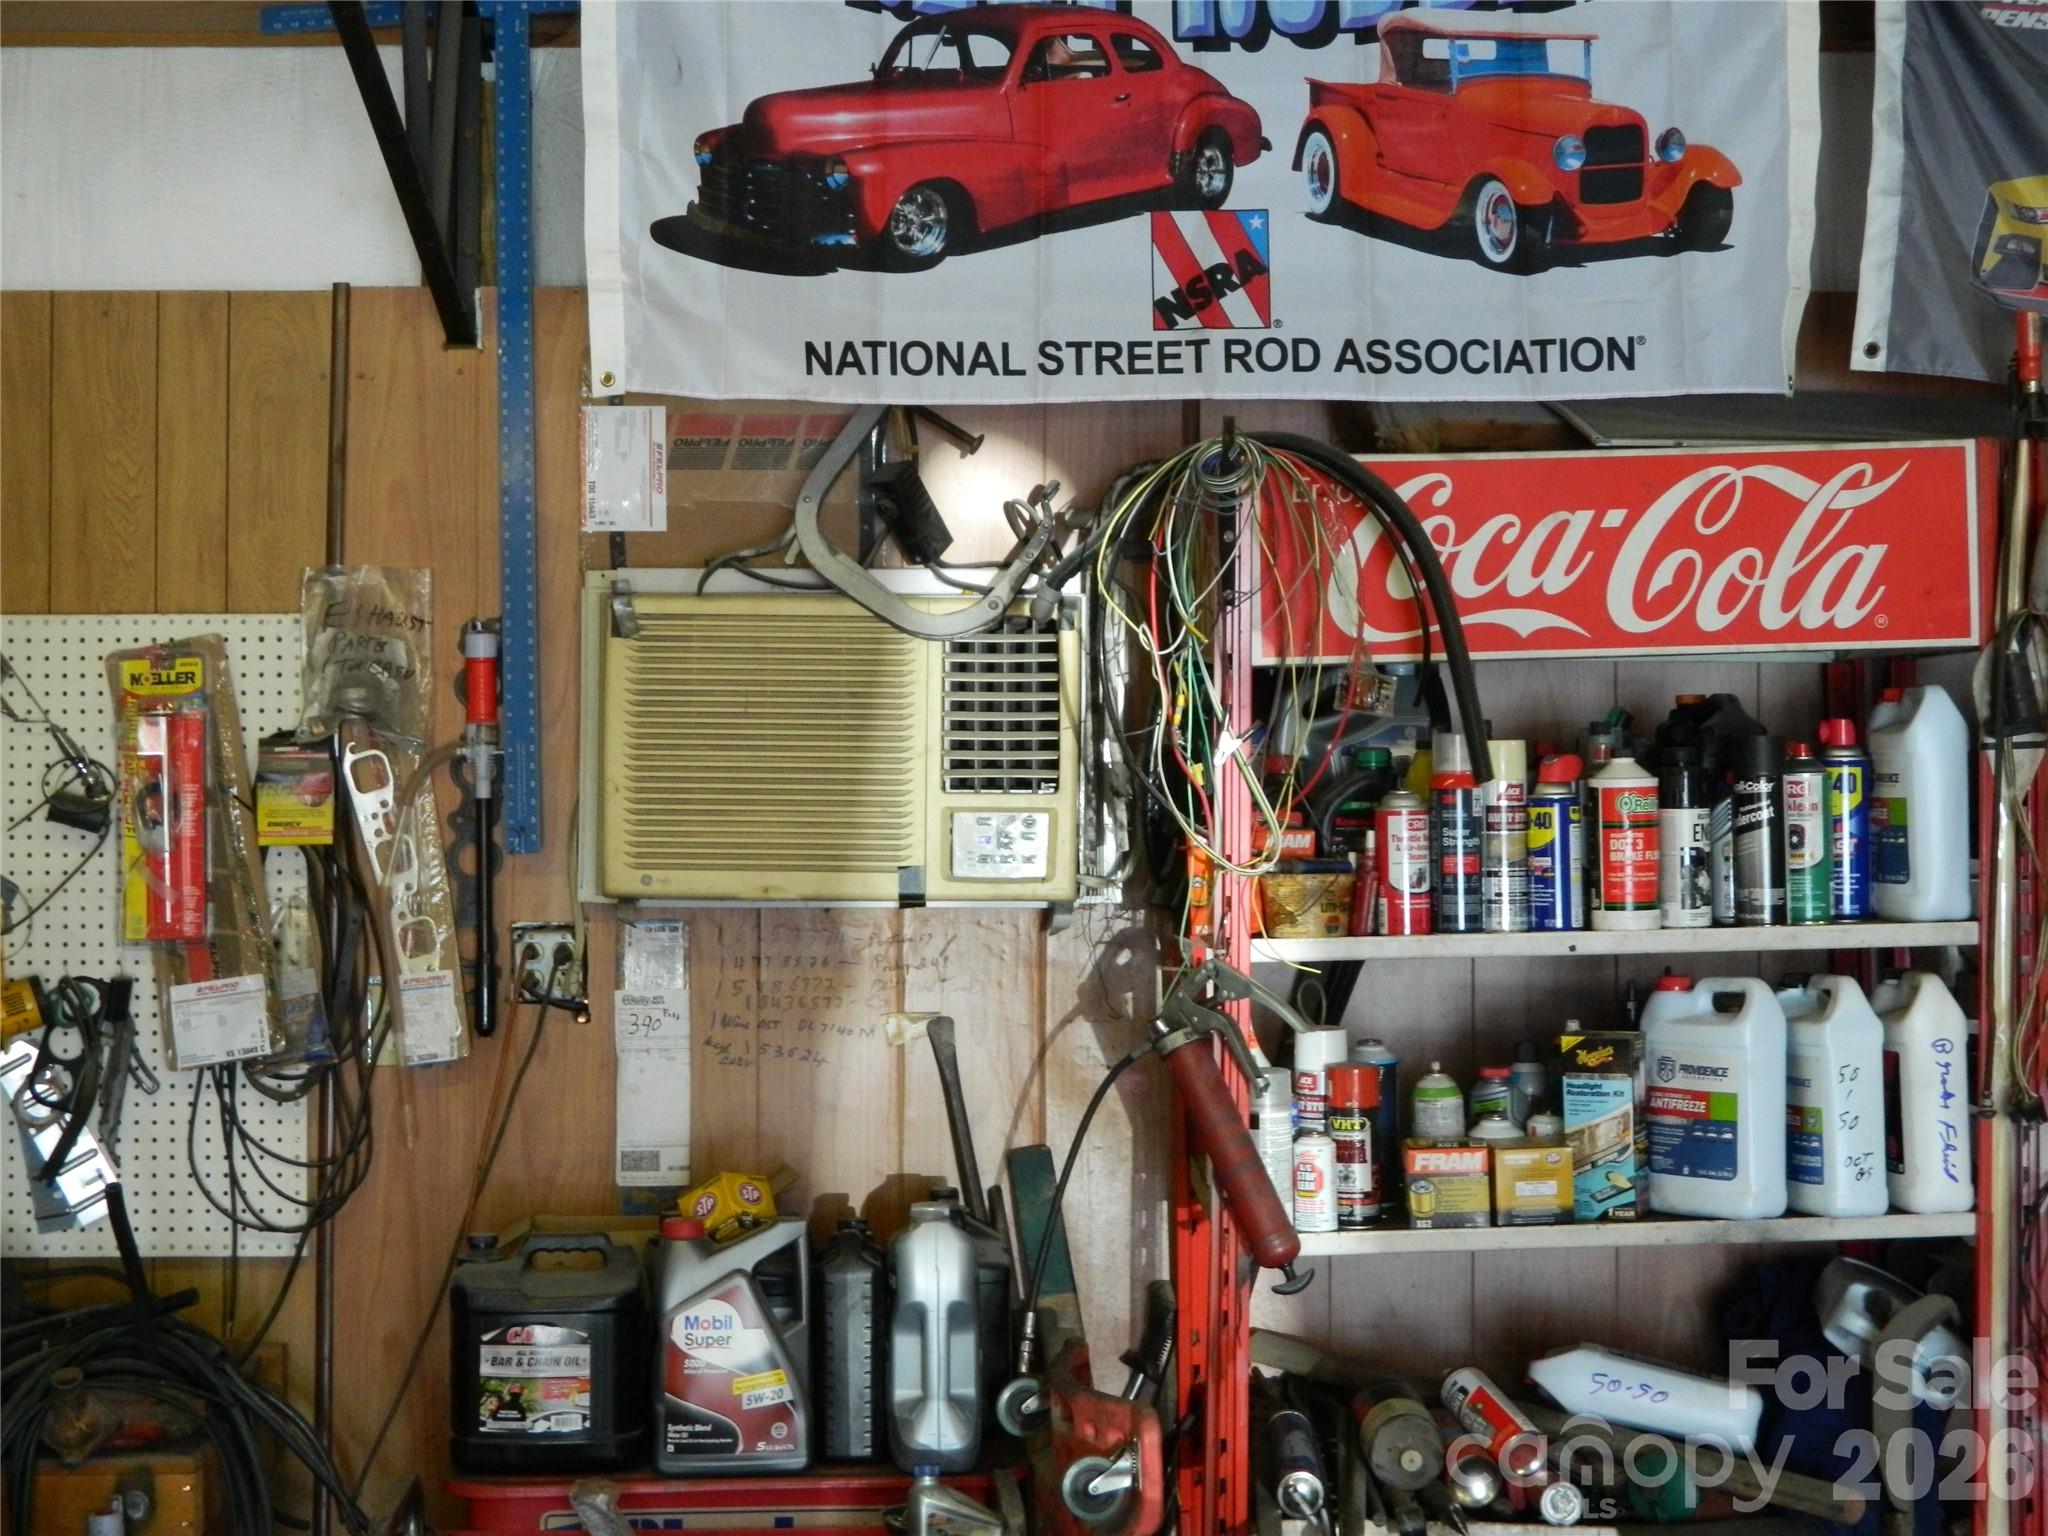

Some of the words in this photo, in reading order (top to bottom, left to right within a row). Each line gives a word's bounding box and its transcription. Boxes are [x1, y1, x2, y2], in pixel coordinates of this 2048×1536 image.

[1153, 248, 1269, 329] NSRA
[805, 340, 1026, 377] NATIONAL
[1037, 339, 1210, 376] STREET
[1223, 338, 1321, 373] ROD
[1334, 336, 1636, 375] ASSOCIATION
[1327, 460, 1911, 643] Coca-Cola
[130, 671, 196, 687] MOELLER
[1637, 838, 1644, 850] 3
[627, 1013, 663, 1038] 390
[1678, 1063, 1729, 1078] PROVIDENCE
[1648, 1096, 1708, 1113] ANTIFREEZE
[1331, 1118, 1364, 1131] VHT
[1838, 1111, 1860, 1131] 50
[1414, 1152, 1483, 1172] FRAM
[741, 1186, 760, 1202] STP
[696, 1197, 714, 1216] STP
[684, 1315, 733, 1331] Mobil
[684, 1332, 733, 1349] Super
[490, 1356, 513, 1367] BAR
[515, 1356, 523, 1367] &
[526, 1356, 561, 1367] CHAIN
[563, 1356, 581, 1367] OIL
[1590, 1372, 1670, 1404] 50-50
[746, 1388, 785, 1406] 5W-20
